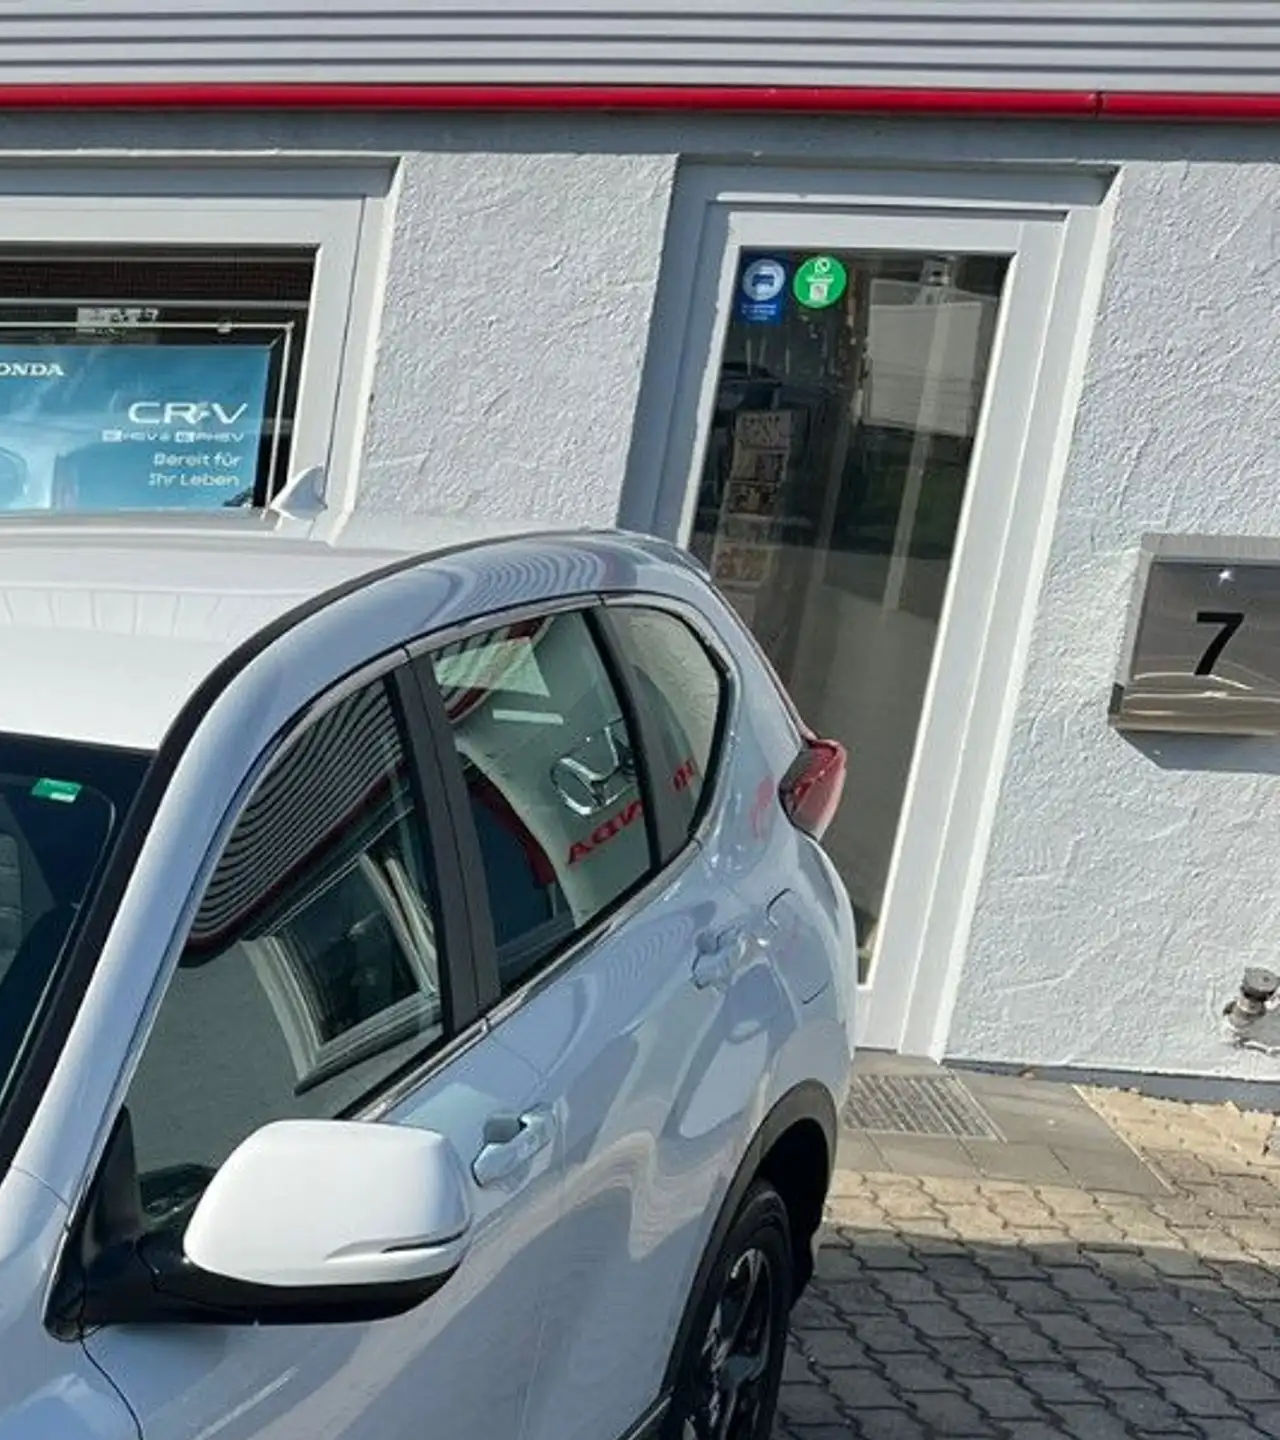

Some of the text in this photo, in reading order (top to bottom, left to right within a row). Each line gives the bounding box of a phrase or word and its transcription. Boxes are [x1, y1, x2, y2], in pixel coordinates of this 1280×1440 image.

[153, 451, 244, 467] Bereit für
[148, 472, 240, 487] Ihr Leben
[1196, 612, 1245, 675] 7
